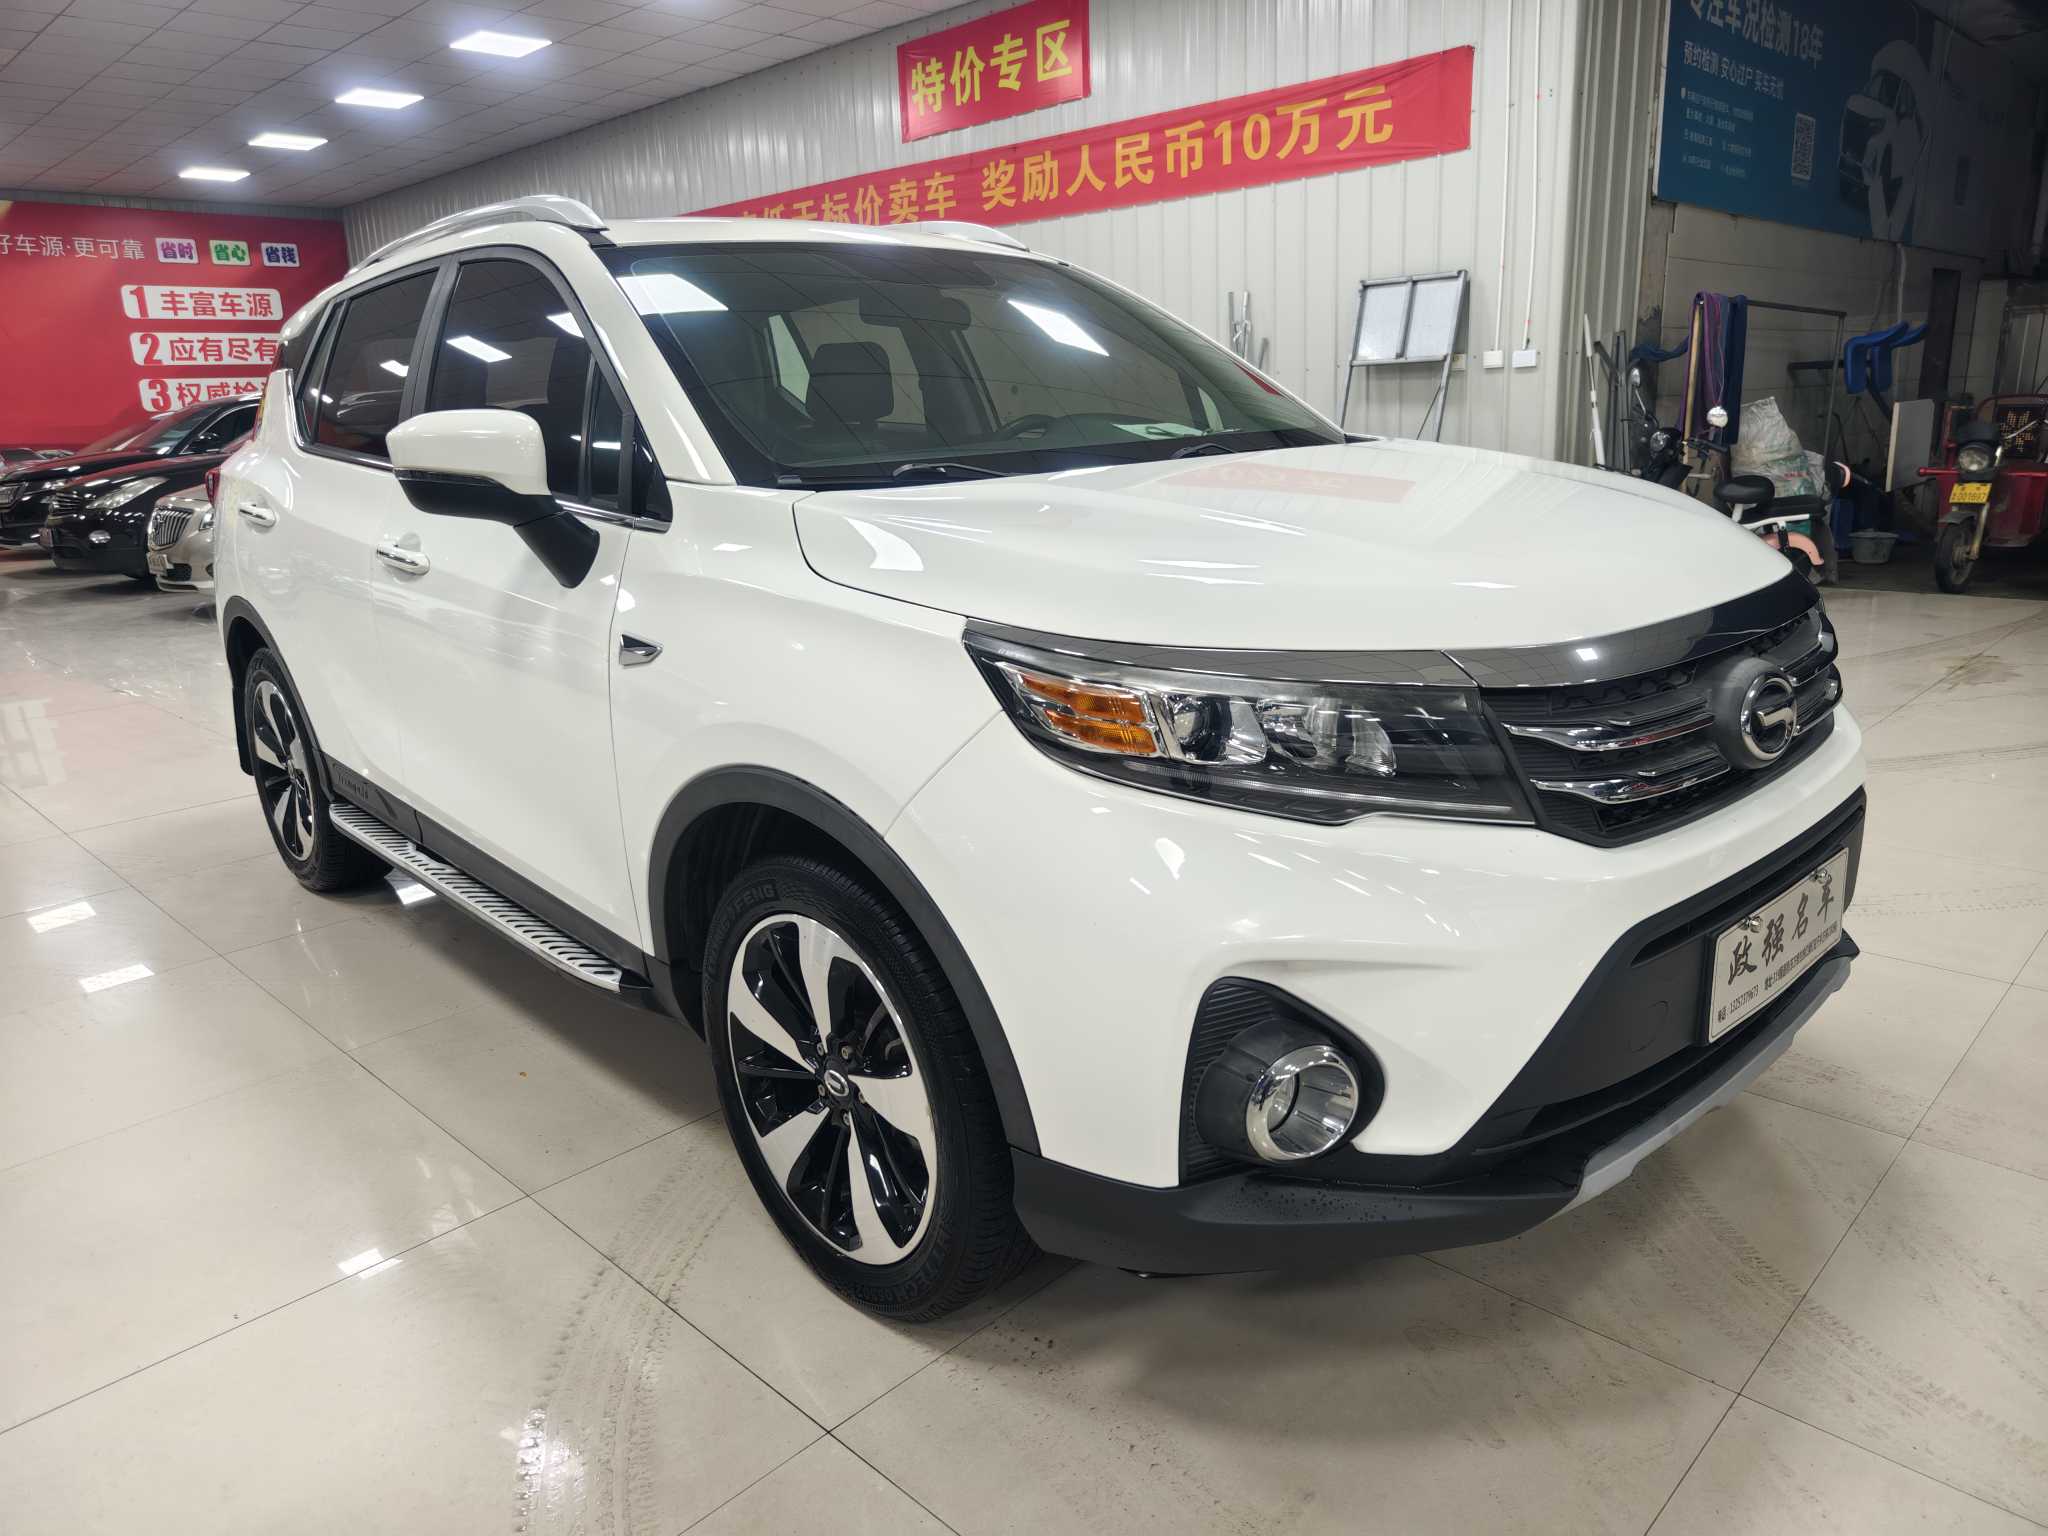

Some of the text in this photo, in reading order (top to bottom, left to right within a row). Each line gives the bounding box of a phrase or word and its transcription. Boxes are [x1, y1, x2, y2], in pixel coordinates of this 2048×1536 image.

[911, 19, 1074, 117] 特价专区
[743, 84, 1394, 225] 于标价卖车 奖励人民币10万元
[160, 240, 195, 260] 省时
[214, 243, 247, 262] 省心
[265, 246, 297, 265] 省钱
[129, 285, 273, 319] 1 丰富车源
[139, 332, 278, 366] 2 应有尽有
[149, 379, 267, 411] 3 权威检
